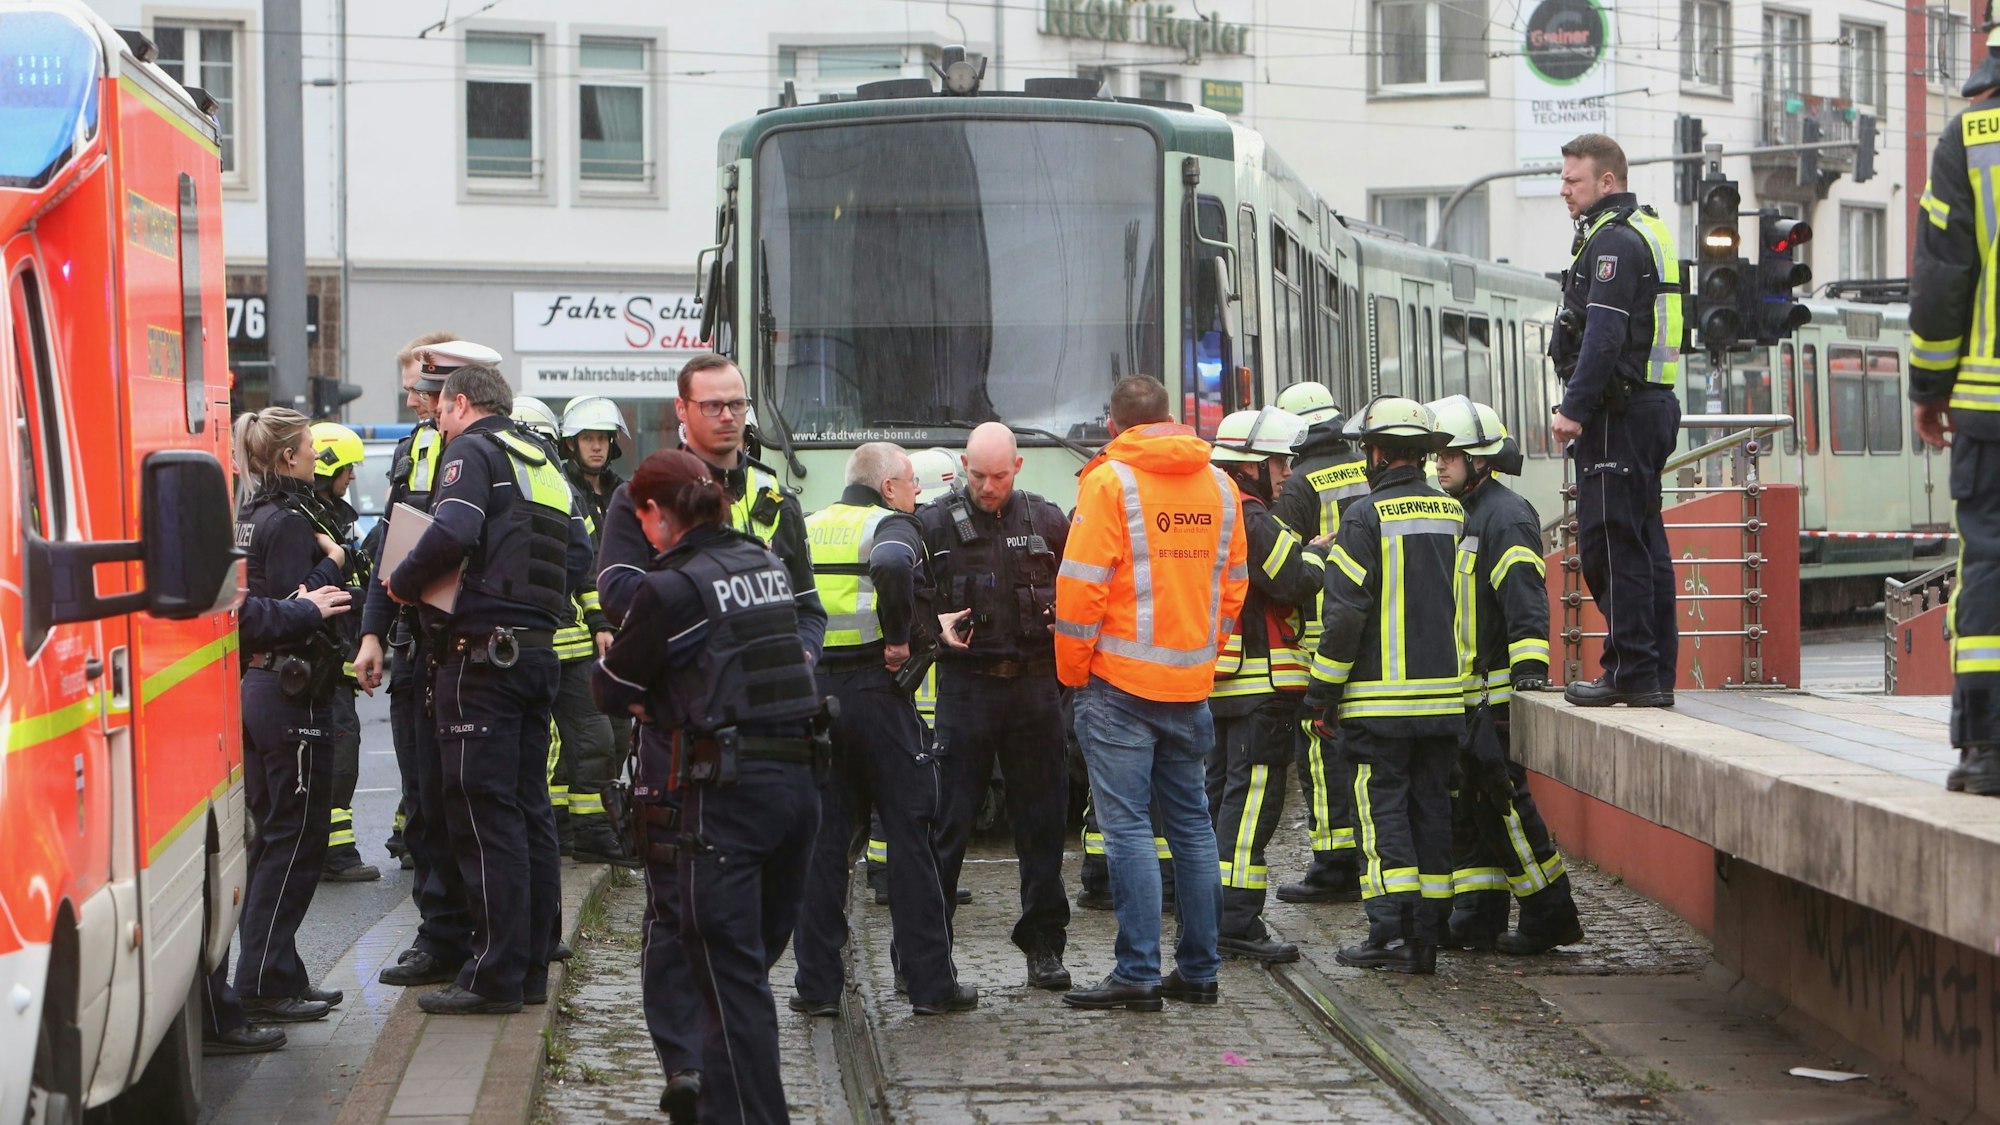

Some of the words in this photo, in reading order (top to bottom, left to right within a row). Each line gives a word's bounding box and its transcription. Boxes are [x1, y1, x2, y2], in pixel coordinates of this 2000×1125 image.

[1531, 101, 1554, 112] DIE
[1412, 409, 1418, 418] 2
[791, 429, 928, 441] www.stadtwerke-bonn.de
[1311, 468, 1362, 487] FEUERWEHR
[1379, 502, 1441, 517] FEUERWEHR
[1442, 502, 1464, 517] BONN
[1173, 513, 1213, 525] SWB
[1159, 549, 1210, 559] BETRIEBSLEITER
[298, 728, 322, 737] POLIZEI
[450, 724, 475, 734] POLIZEI
